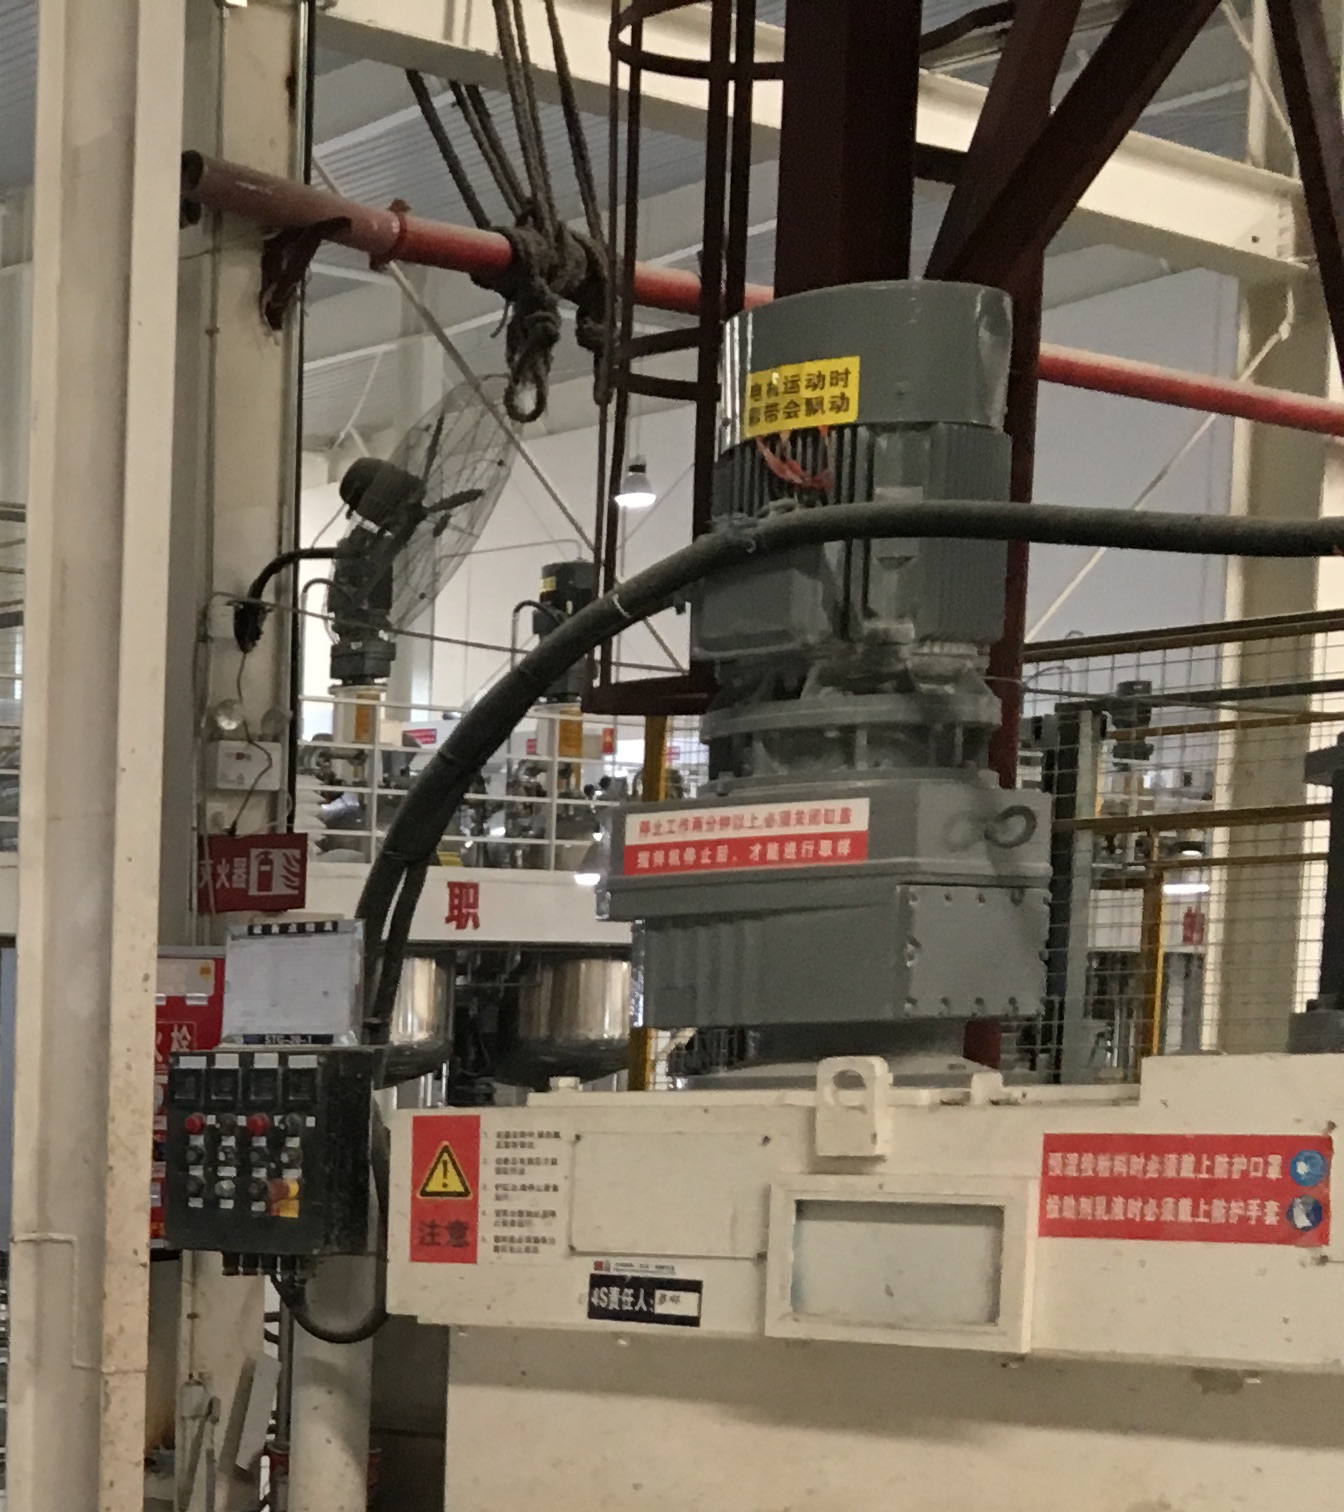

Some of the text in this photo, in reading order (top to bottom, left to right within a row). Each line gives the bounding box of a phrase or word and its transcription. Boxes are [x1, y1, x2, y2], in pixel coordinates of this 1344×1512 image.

[198, 856, 248, 889] 灭火器
[444, 881, 481, 931] 职
[418, 1218, 470, 1249] 注意
